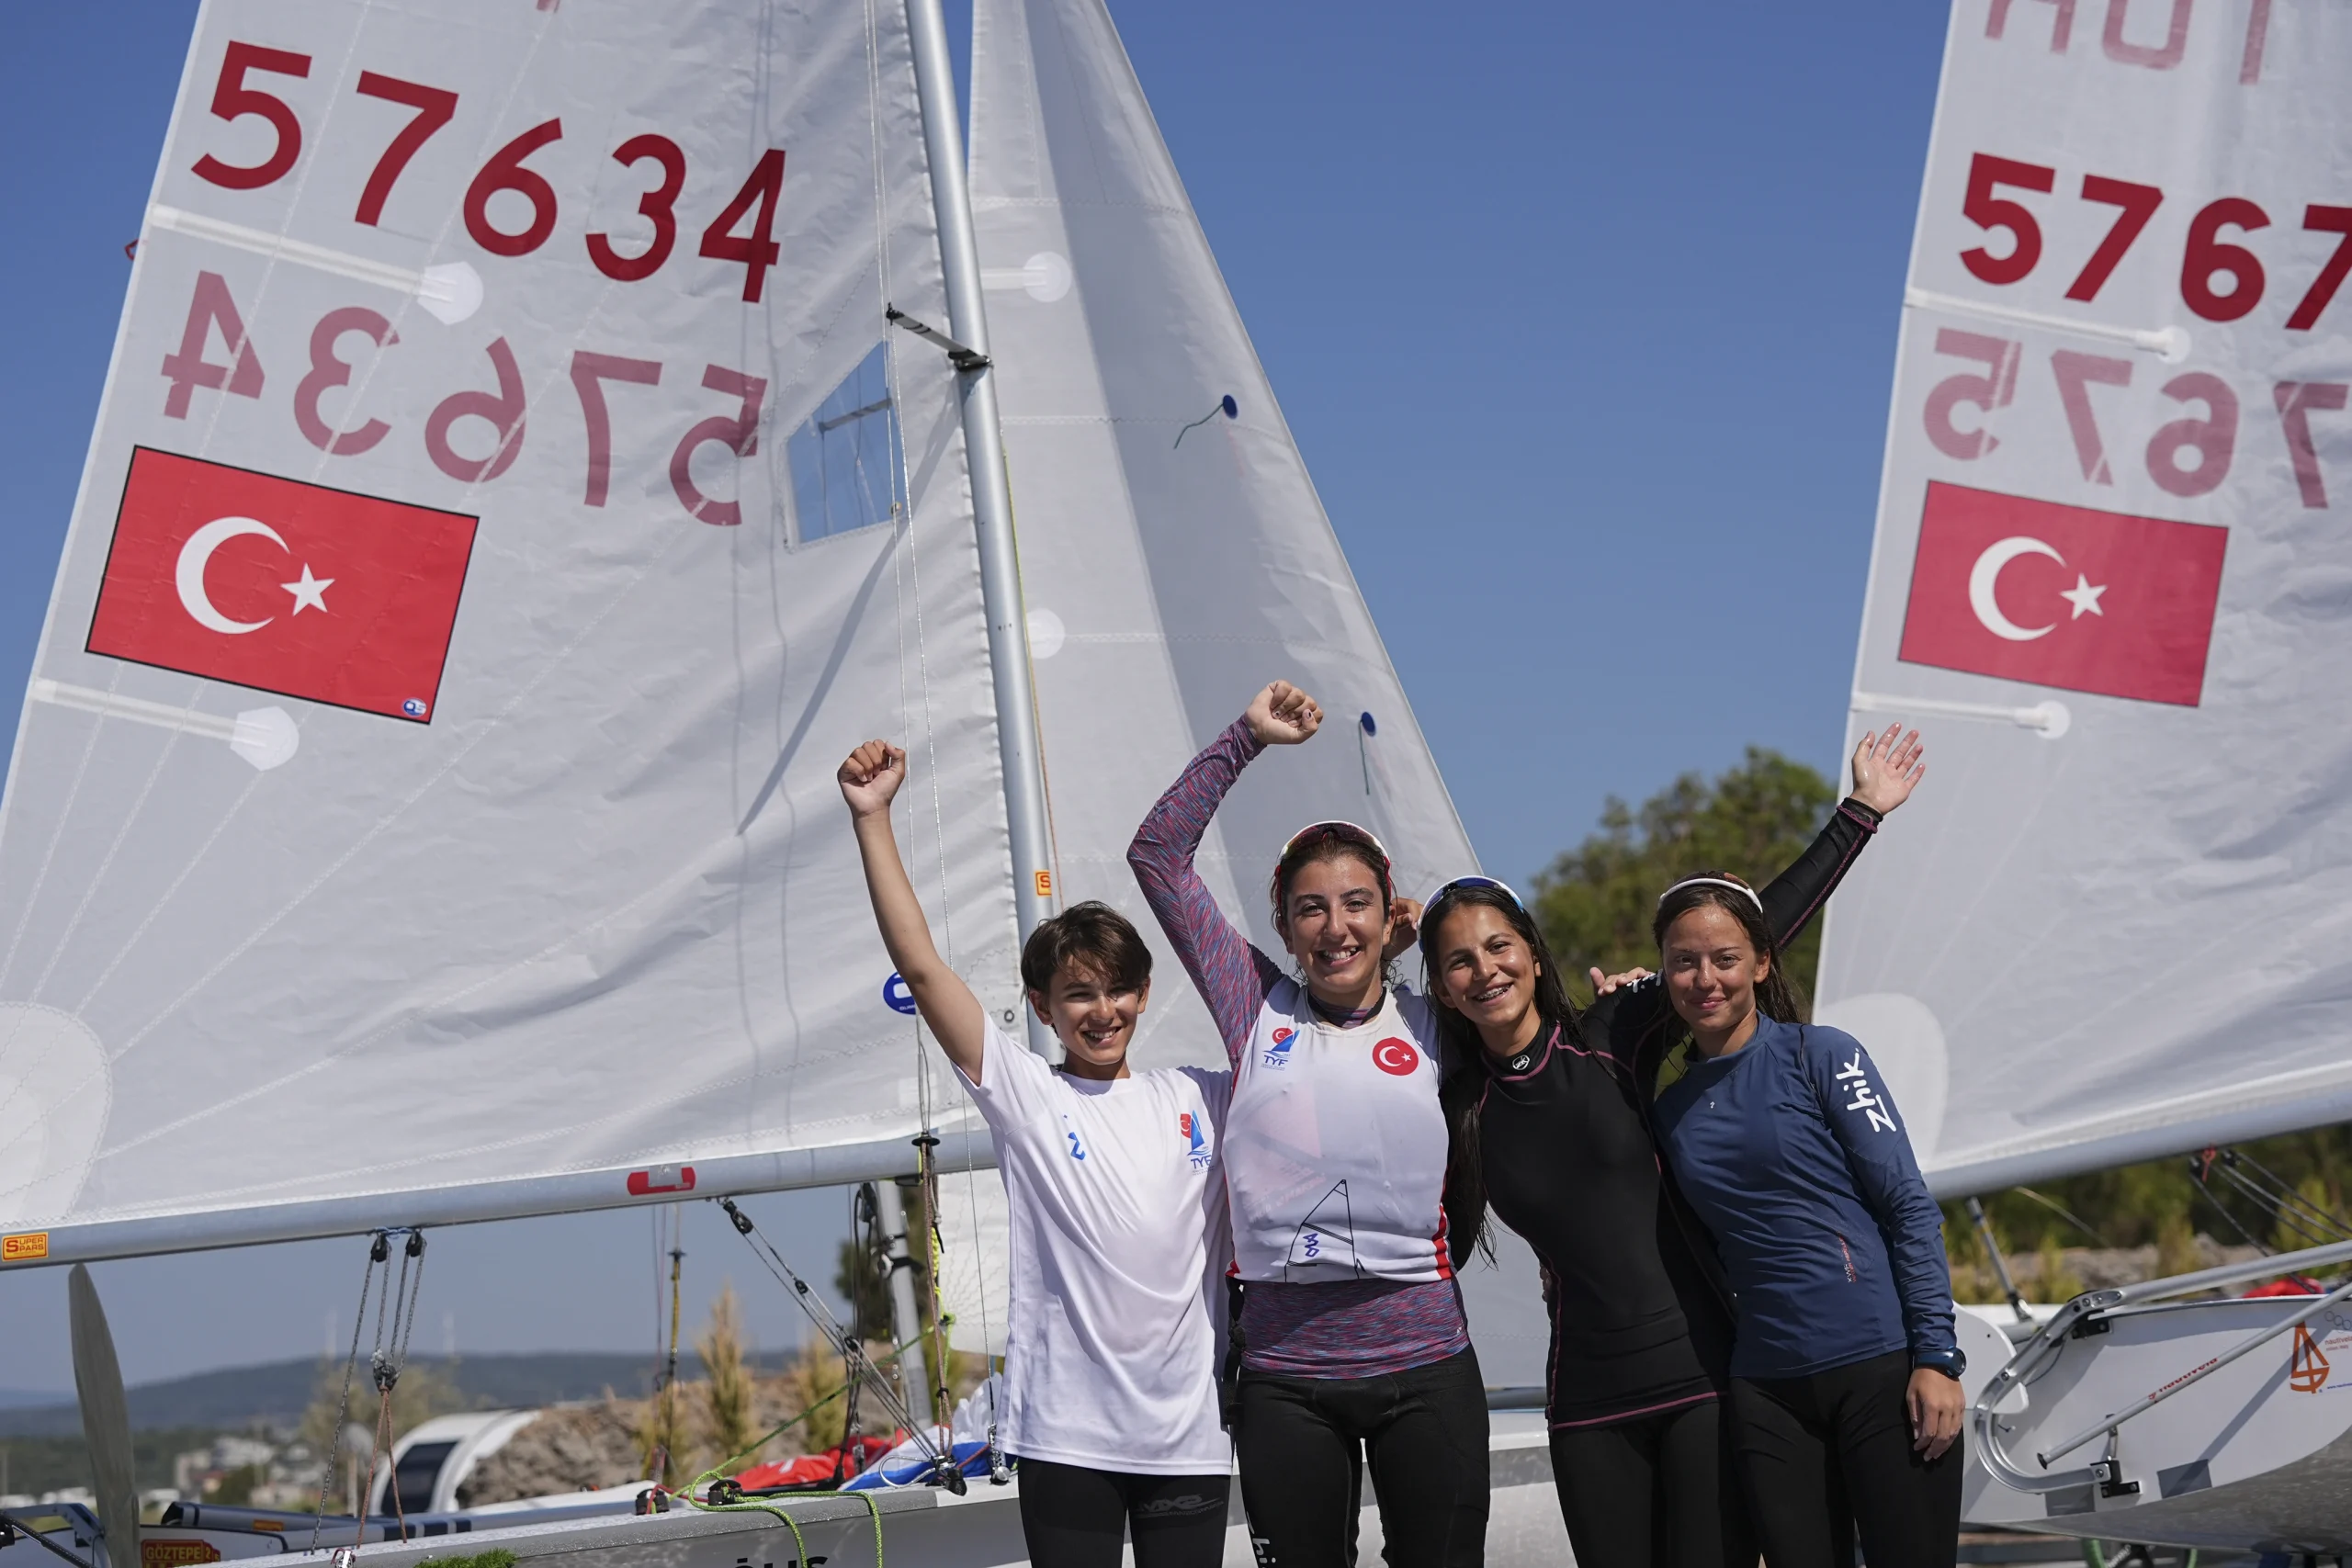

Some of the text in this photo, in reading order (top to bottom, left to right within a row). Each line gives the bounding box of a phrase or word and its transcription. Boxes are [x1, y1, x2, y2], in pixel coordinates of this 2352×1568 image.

[191, 40, 786, 303] 57634
[1960, 152, 2352, 332] 5767
[1264, 1055, 1288, 1066] TYF
[145, 1544, 201, 1560] GÖZTEPE
